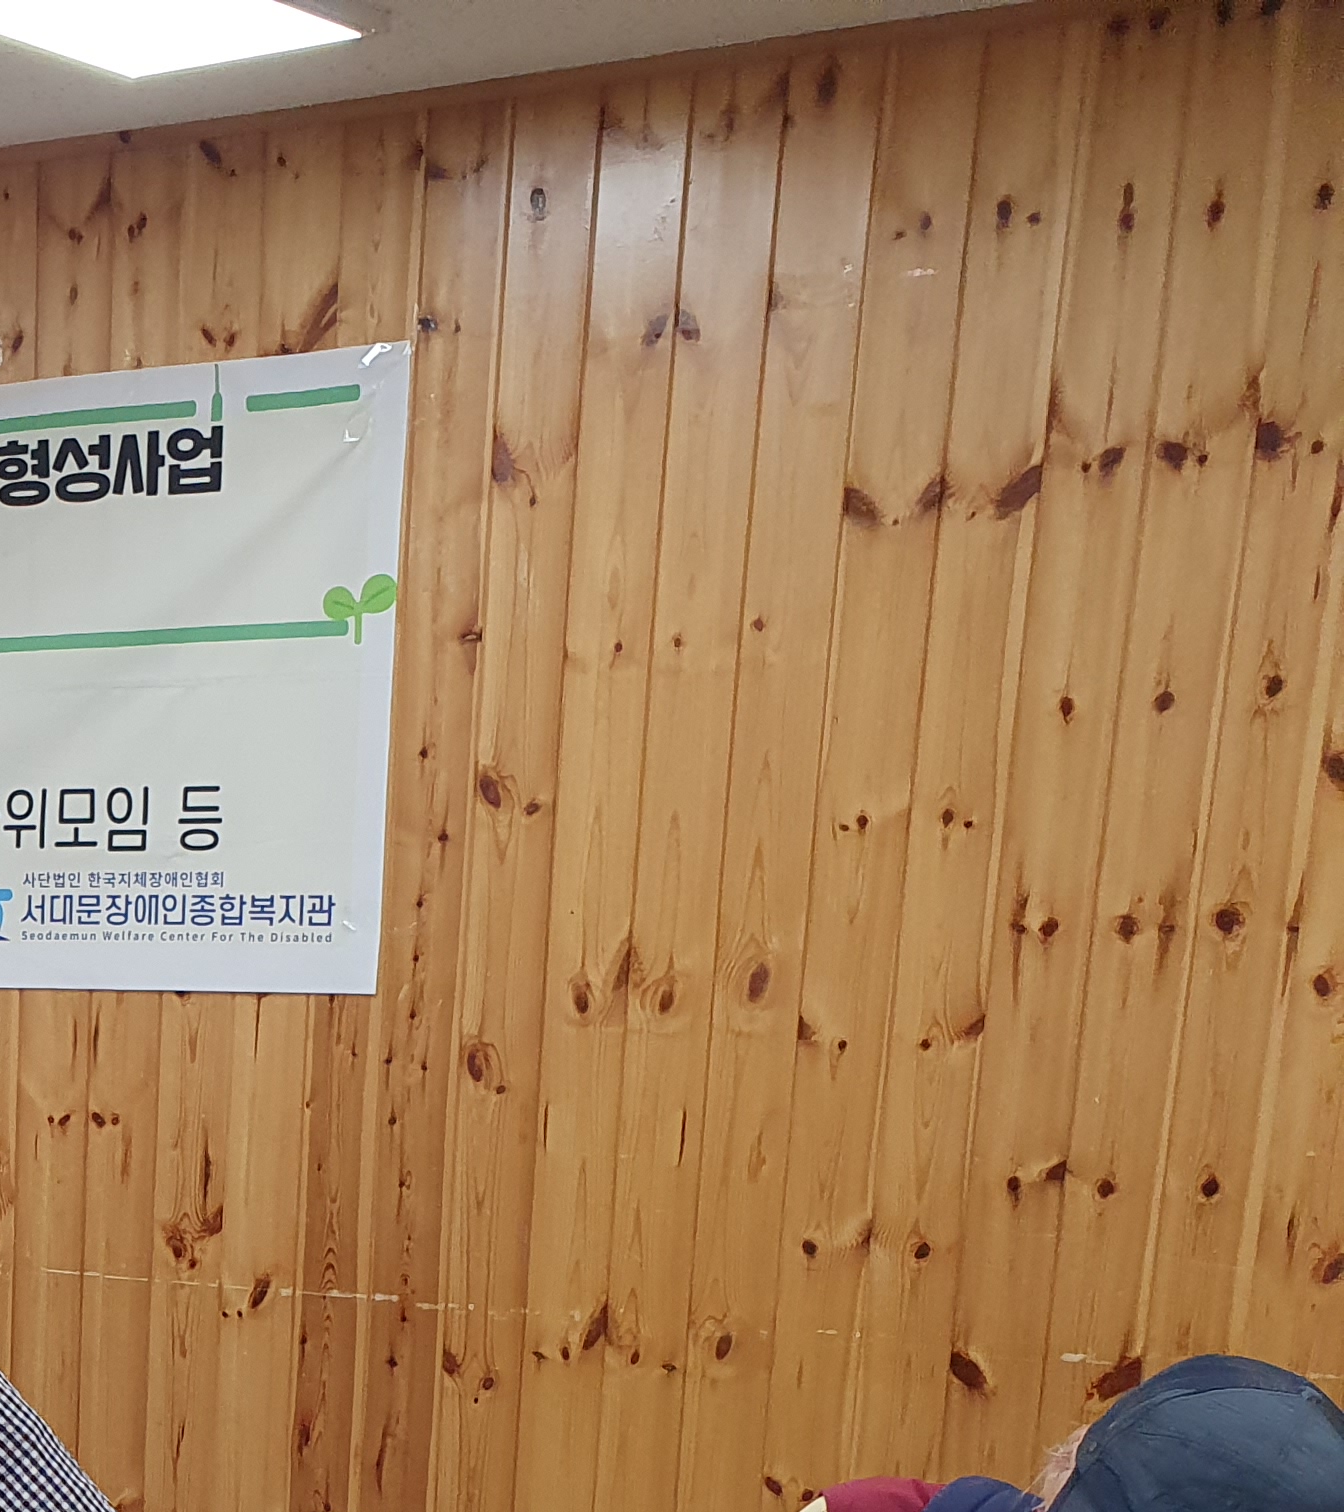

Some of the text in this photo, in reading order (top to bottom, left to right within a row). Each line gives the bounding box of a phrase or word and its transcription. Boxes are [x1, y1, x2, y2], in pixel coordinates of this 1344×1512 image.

[177, 785, 223, 852] 등
[22, 871, 224, 889] 사단법인 한국지체장애인협회
[20, 893, 337, 927] 서대문장애인종합복지관
[21, 930, 333, 944] Seodaemun Welfare Center For The Disabled
